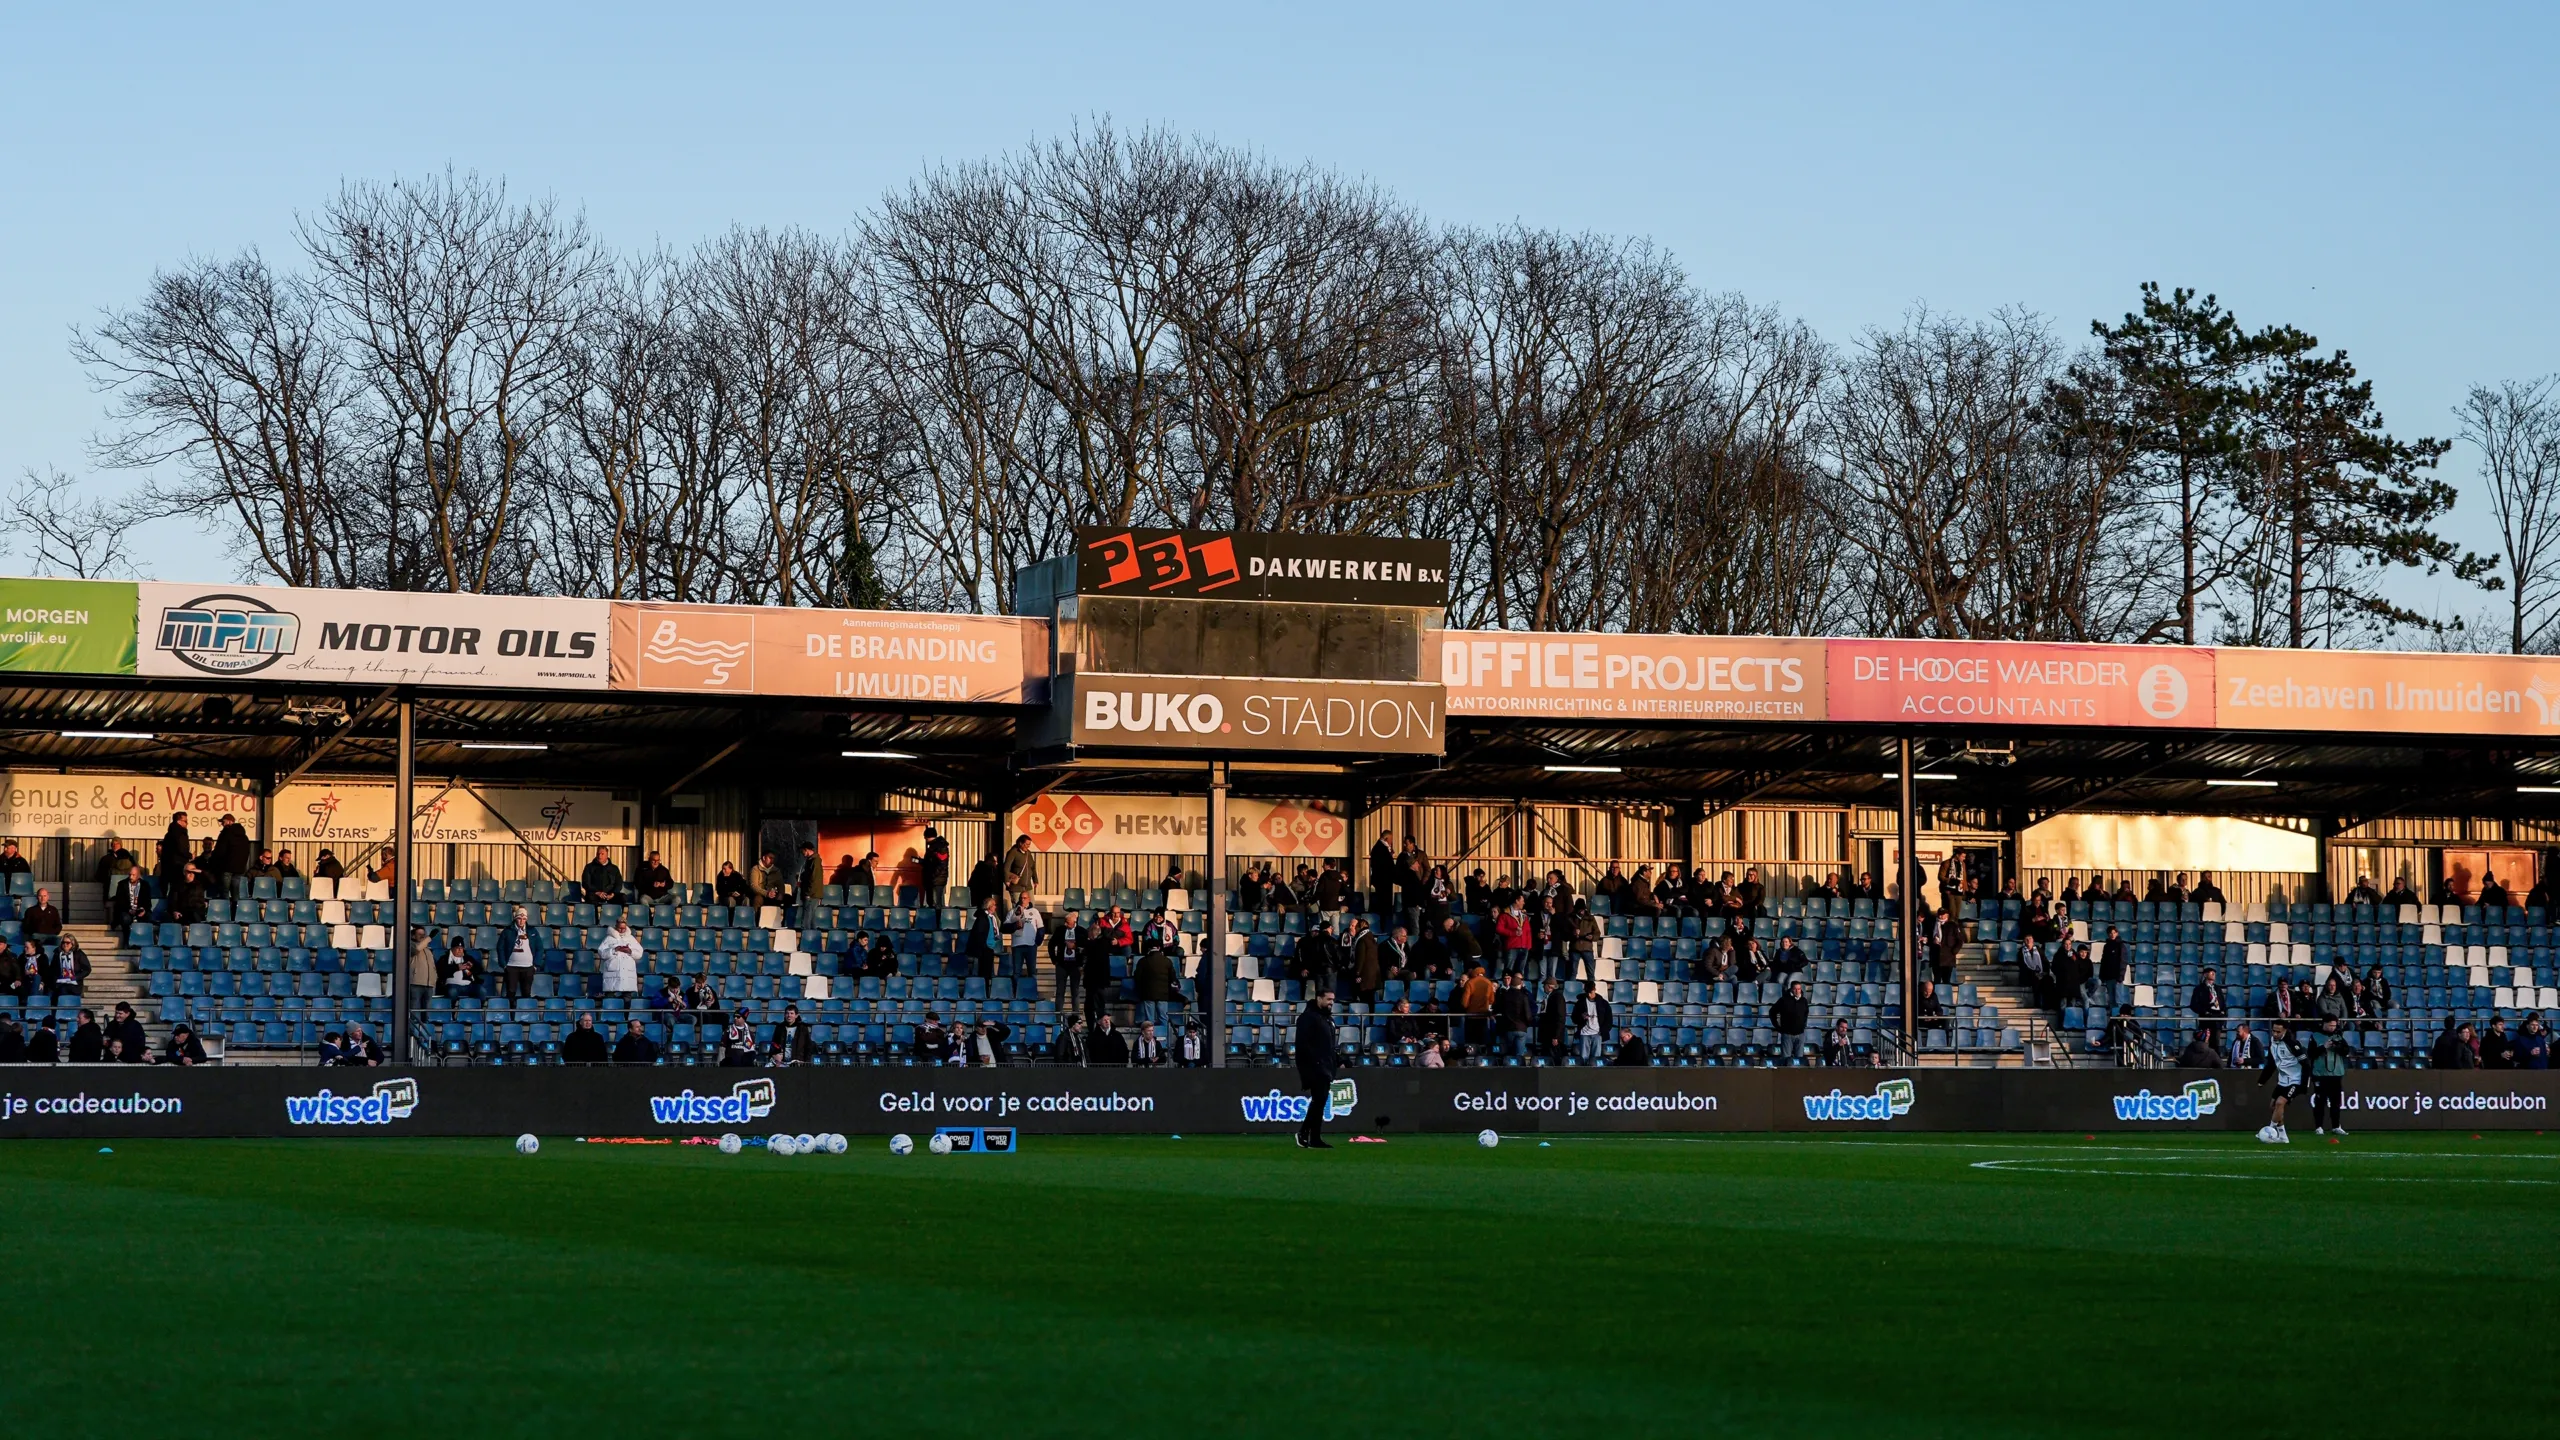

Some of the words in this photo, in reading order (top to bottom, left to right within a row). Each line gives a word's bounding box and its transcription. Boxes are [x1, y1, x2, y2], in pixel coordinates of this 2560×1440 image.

[1088, 532, 1241, 592] PBL
[1249, 557, 1412, 582] DAKWERKEN
[1418, 567, 1444, 583] B.V.
[6, 609, 88, 625] MORGEN
[842, 617, 961, 633] Aannemingsmaatschappij
[318, 622, 481, 655] MOTOR
[497, 629, 597, 659] OILS
[806, 633, 842, 658] DE
[851, 634, 997, 664] BRANDING
[191, 653, 208, 665] OIL
[210, 655, 261, 669] COMPANY
[366, 658, 417, 682] things
[1442, 640, 1598, 689] OFFICE
[1606, 655, 1804, 692] PROJECTS
[1854, 656, 1889, 681] DE
[1899, 656, 1989, 684] HOOGE
[1997, 659, 2129, 686] WAERDER
[835, 671, 968, 699] IJMUIDEN
[2228, 676, 2374, 709] Zeehaven
[2386, 681, 2521, 713] IJmuiden
[1242, 695, 1435, 739] STADION
[1445, 696, 1612, 712] KANTOORINRICHTING
[1616, 700, 1627, 712] &
[1632, 699, 1804, 715] INTERIEURPROJECTEN
[1901, 695, 2096, 718] ACCOUNTANTS
[90, 784, 109, 810] &
[120, 785, 154, 810] de
[165, 786, 256, 812] Waard
[27, 811, 74, 828] repair
[79, 811, 108, 826] and
[280, 827, 311, 838] PRIM
[1115, 814, 1247, 837] HEKWEK
[1, 1092, 28, 1119] je
[35, 1092, 182, 1114] cadeaubon
[879, 1091, 935, 1112] Geld
[942, 1096, 993, 1112] voor
[998, 1092, 1020, 1117] je
[1026, 1091, 1154, 1112] cadeaubon
[1454, 1091, 1507, 1112] Geld
[1514, 1096, 1562, 1111] voor
[1568, 1091, 1589, 1116] je
[1595, 1090, 1718, 1111] cadeaubon
[2365, 1095, 2407, 1110] voor
[2412, 1091, 2432, 1115] je
[2438, 1091, 2547, 1110] cadeaubon
